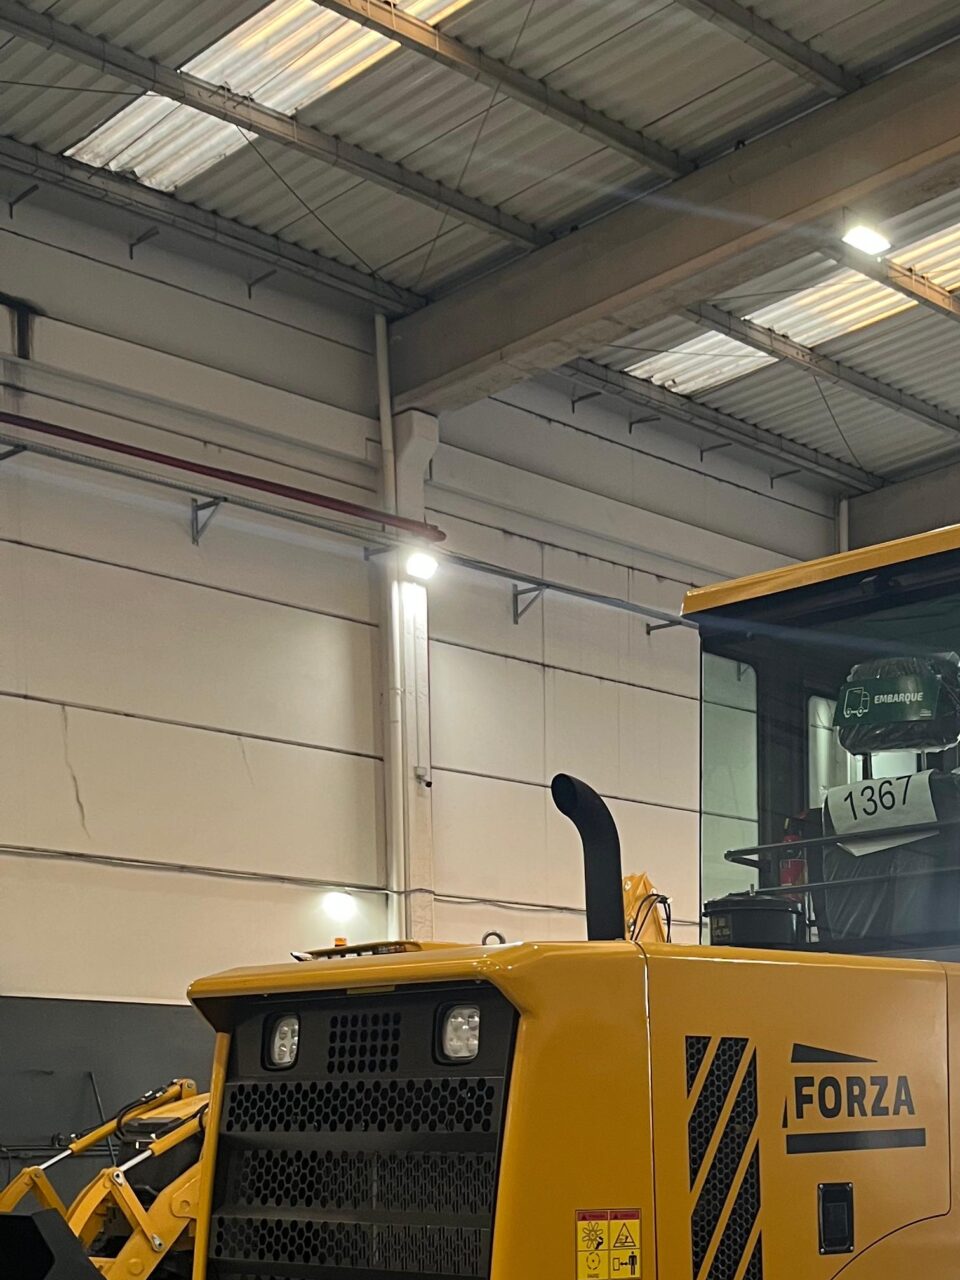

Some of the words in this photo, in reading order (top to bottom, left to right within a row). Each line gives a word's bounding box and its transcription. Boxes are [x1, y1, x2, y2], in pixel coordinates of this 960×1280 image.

[874, 692, 923, 705] EMBARQUE
[844, 775, 912, 820] 1367
[794, 1075, 916, 1119] FORZA
